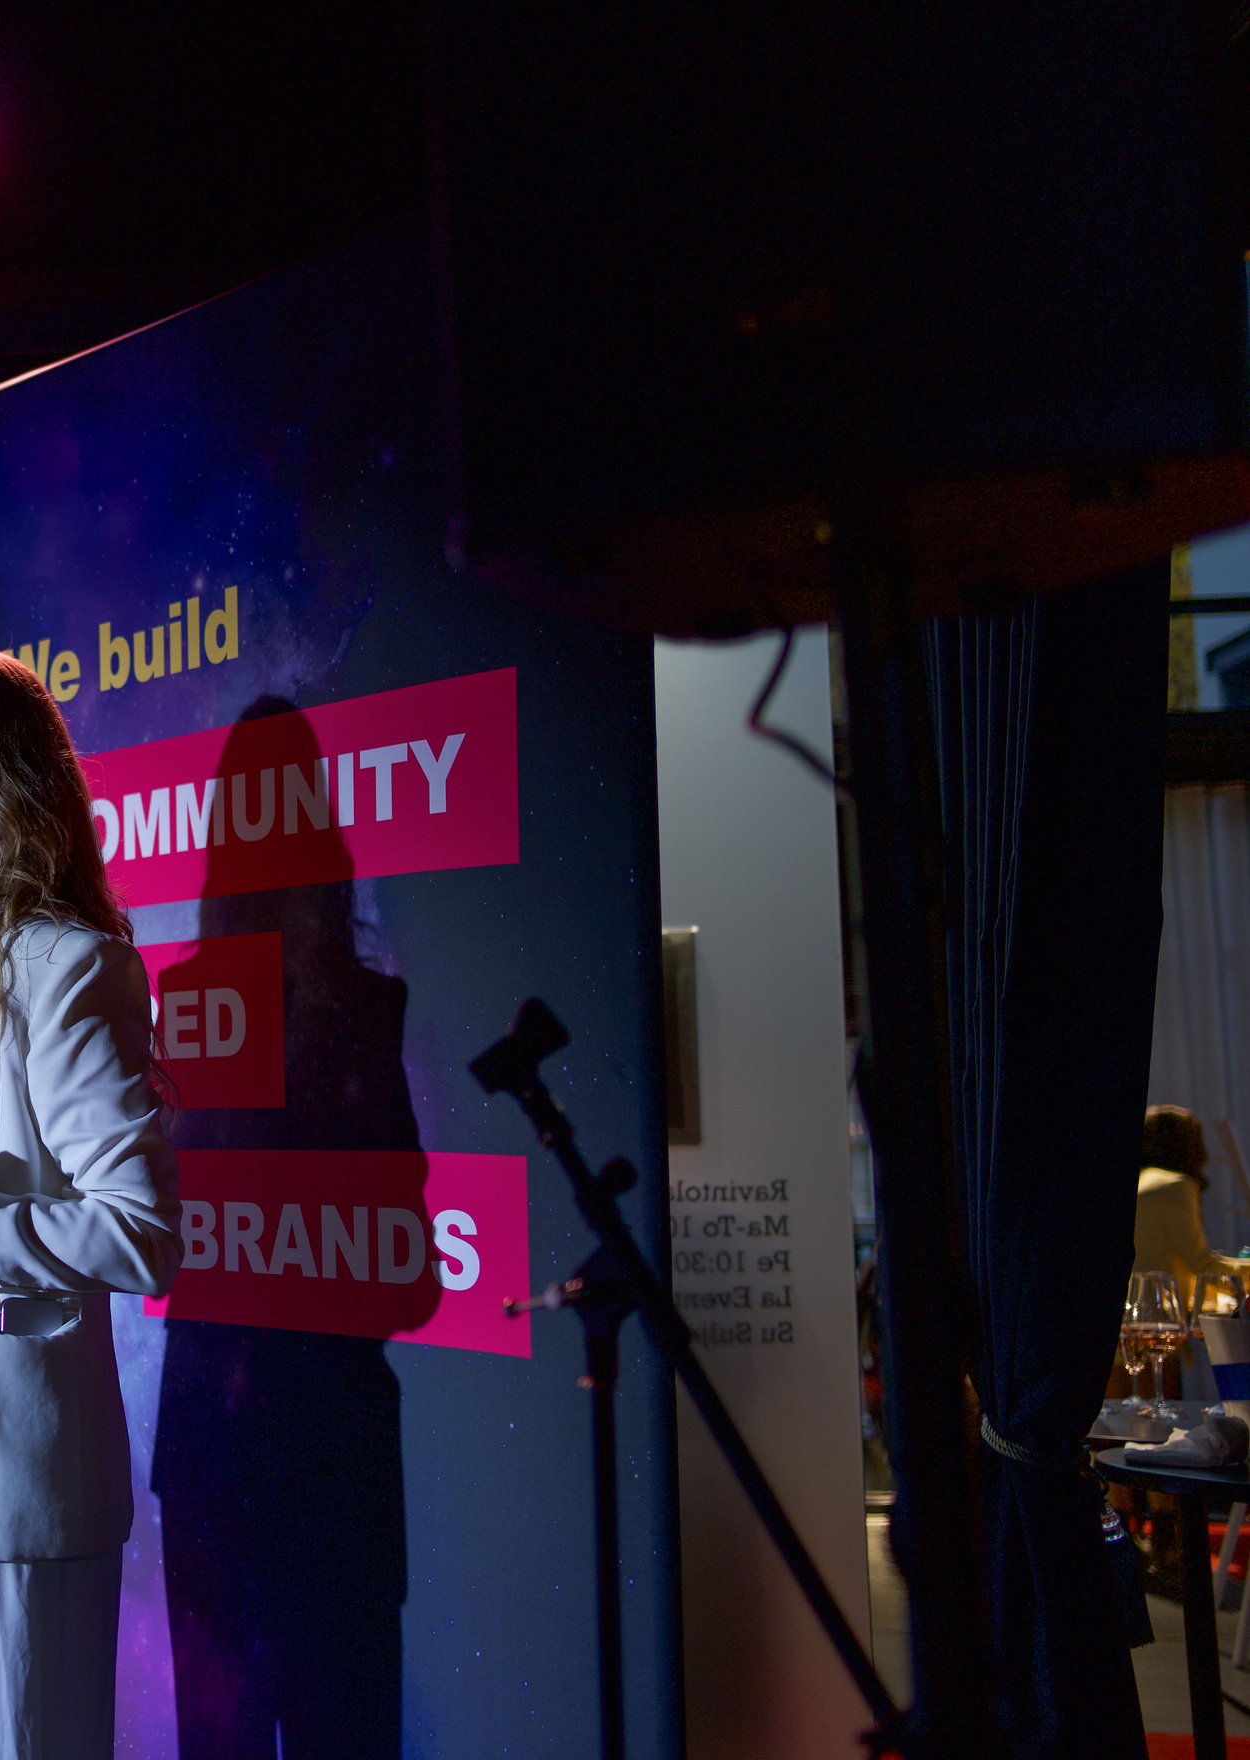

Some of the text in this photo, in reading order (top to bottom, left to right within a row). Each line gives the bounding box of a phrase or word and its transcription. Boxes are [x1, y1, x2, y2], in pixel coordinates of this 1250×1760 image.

[98, 584, 239, 693] build
[150, 986, 247, 1061] ED
[179, 1199, 481, 1292] BRANDS
